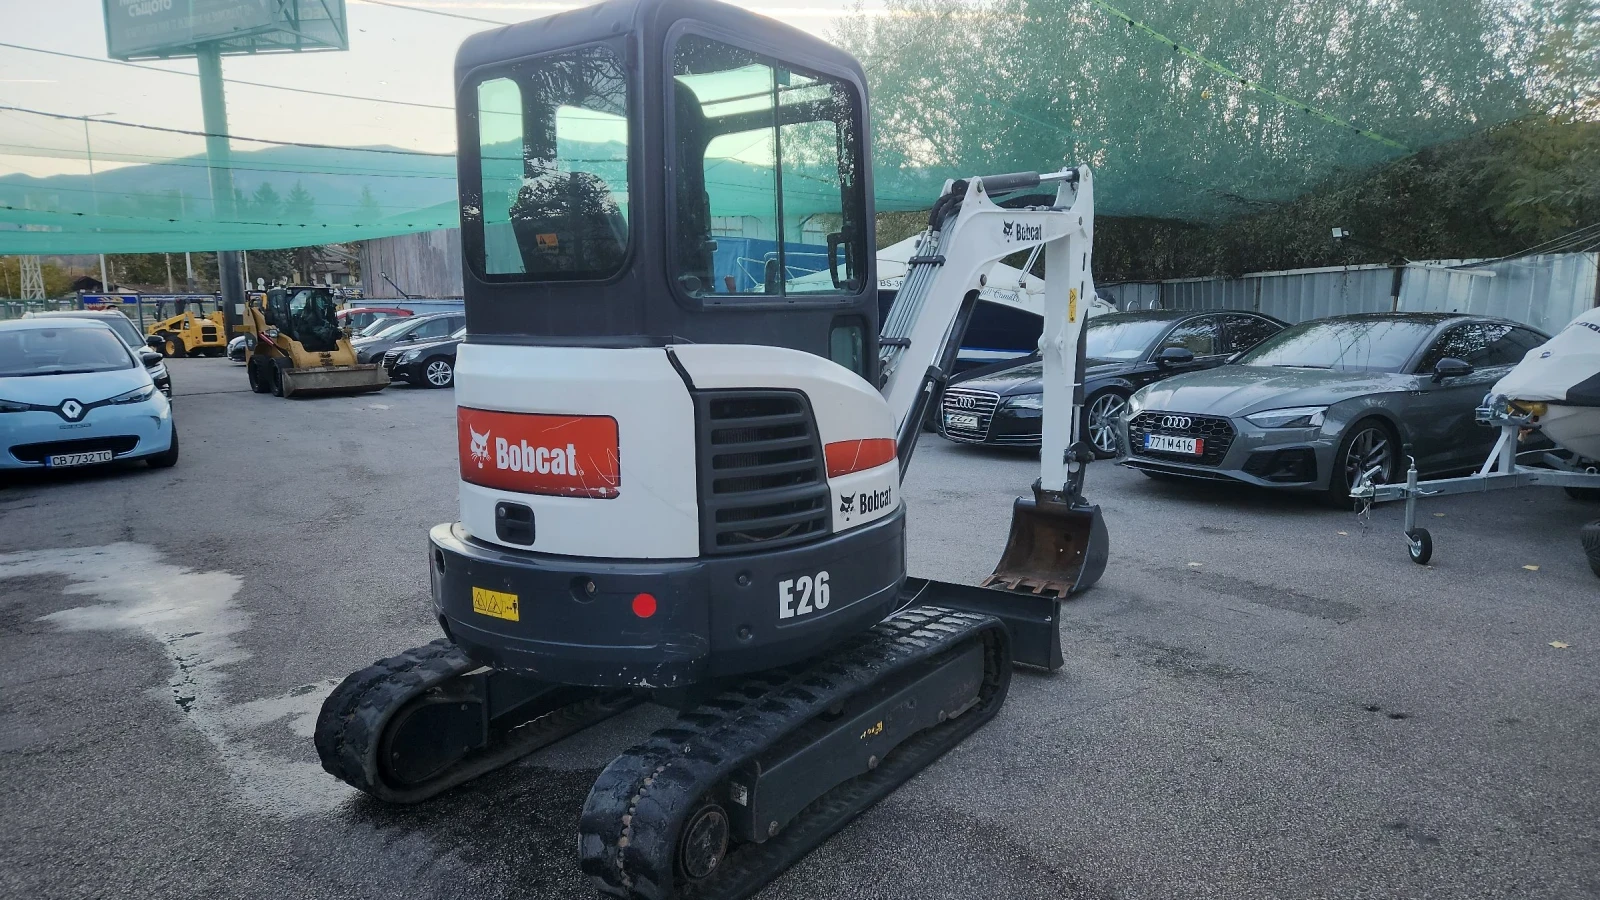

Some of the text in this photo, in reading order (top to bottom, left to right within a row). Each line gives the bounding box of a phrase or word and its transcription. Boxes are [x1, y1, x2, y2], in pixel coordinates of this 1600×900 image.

[1016, 223, 1042, 241] Bobcat
[495, 436, 577, 476] Bobcat
[859, 484, 892, 515] Bobcat
[778, 569, 830, 619] E26
